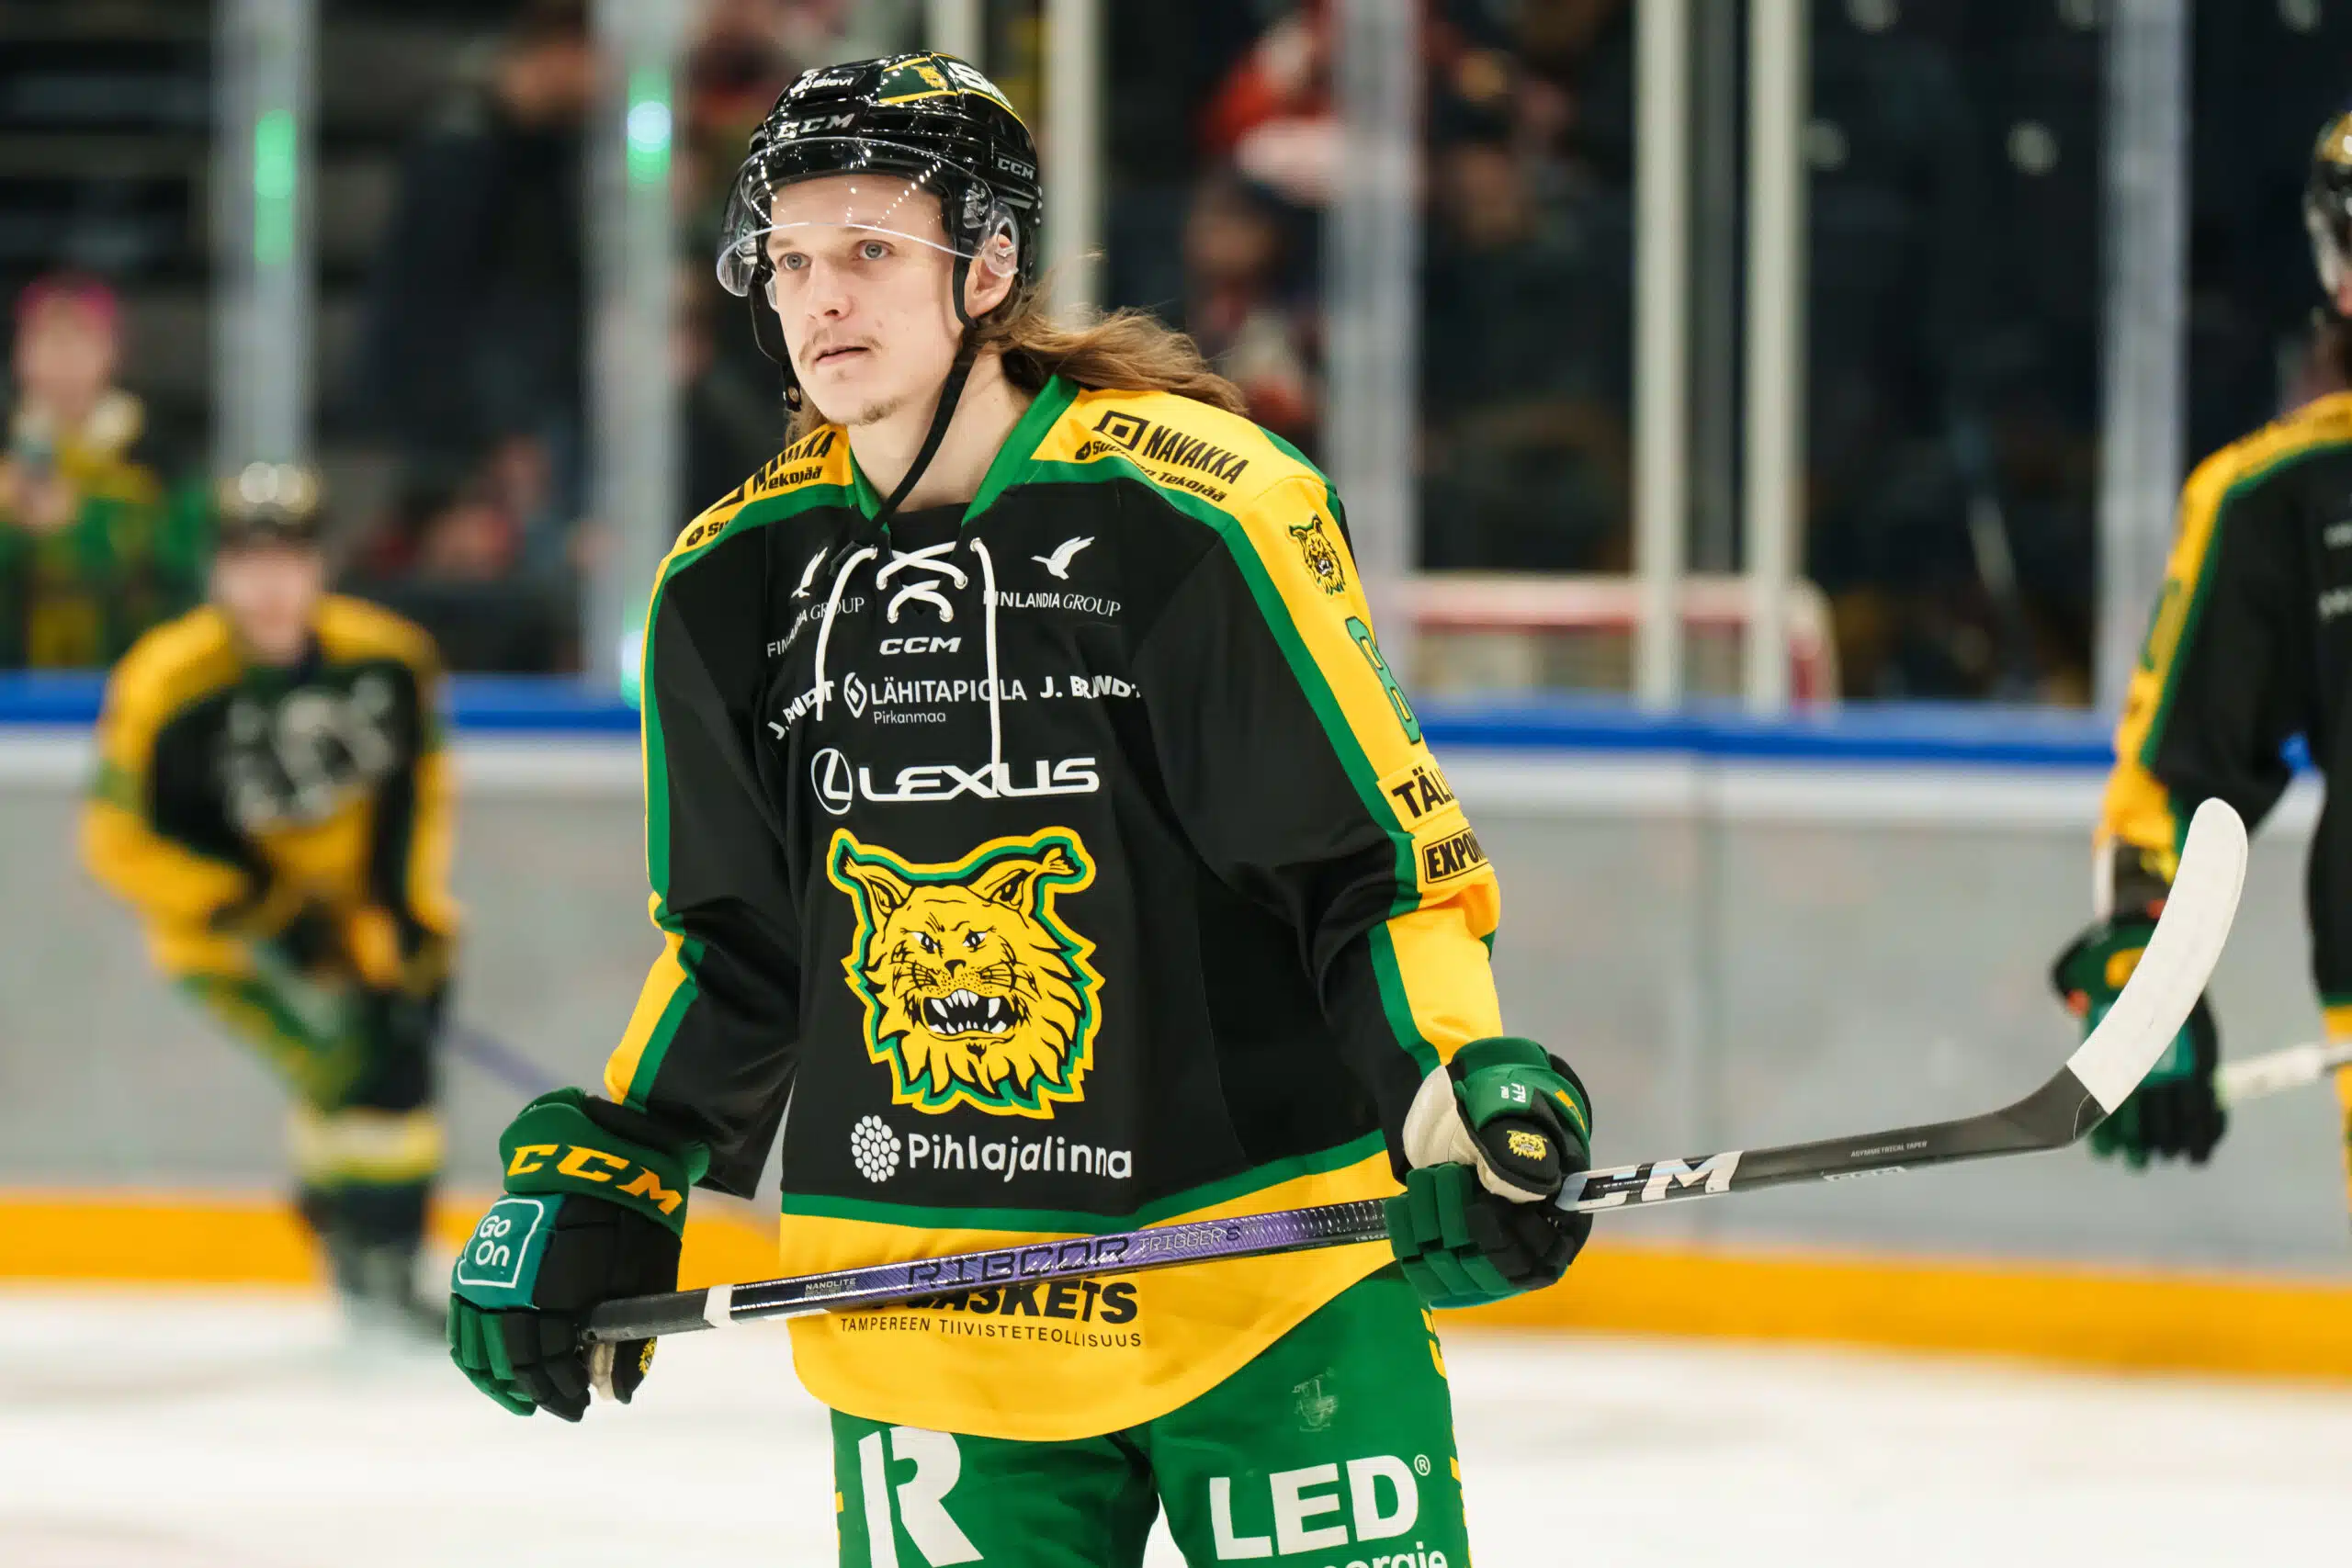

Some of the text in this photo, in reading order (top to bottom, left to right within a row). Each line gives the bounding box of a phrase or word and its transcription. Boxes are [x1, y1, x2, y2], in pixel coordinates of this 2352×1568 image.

[777, 113, 855, 139] CCM
[997, 157, 1035, 180] CCM
[1142, 424, 1250, 485] NAVAKKA
[1158, 470, 1228, 502] Tekojää
[809, 596, 865, 621] GRUP
[1062, 592, 1122, 617] GROUP
[878, 637, 962, 656] CCM
[1039, 675, 1063, 699] J.
[873, 709, 947, 726] Pirkanmaa
[858, 757, 1101, 802] LEXUS
[908, 1133, 1132, 1183] Pihlajalinna
[506, 1143, 684, 1216] CCM
[480, 1214, 511, 1238] Go
[1139, 1226, 1224, 1250] TRIGGER
[475, 1239, 511, 1268] On
[805, 1278, 856, 1292] NANOLITE
[841, 1316, 1142, 1348] TAMPEREEN TIIVISTETEOLLISUUS
